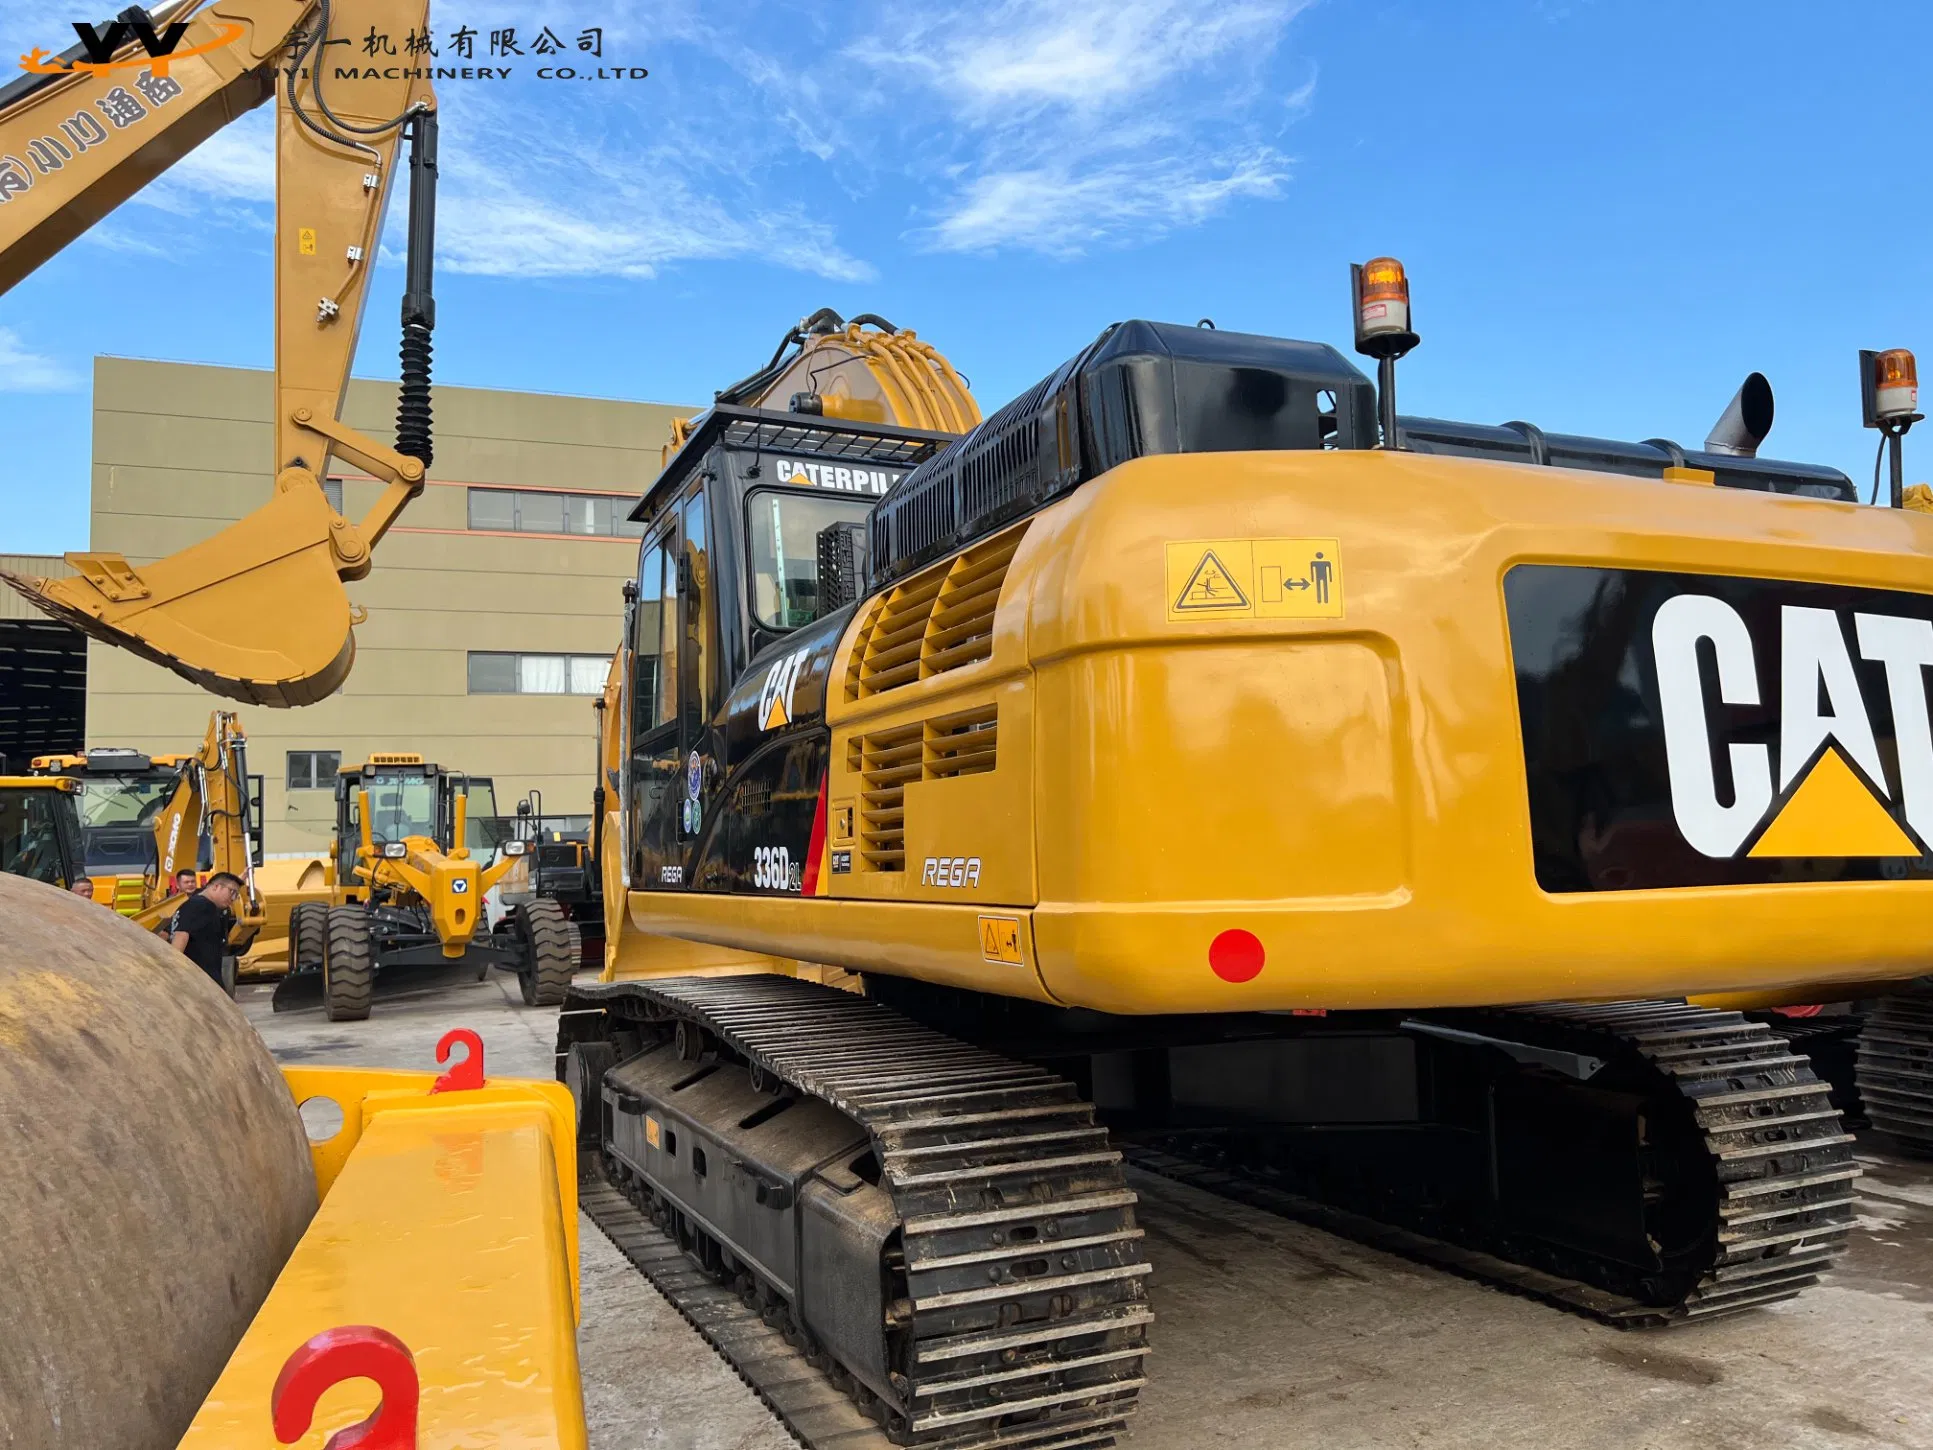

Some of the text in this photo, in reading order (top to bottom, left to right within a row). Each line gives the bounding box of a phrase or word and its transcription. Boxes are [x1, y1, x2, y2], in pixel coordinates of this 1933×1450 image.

[776, 459, 900, 495] CATERPIL
[758, 647, 810, 732] CAT
[1652, 594, 1933, 858] CAT
[661, 866, 683, 883] REGA
[921, 856, 982, 888] REGA
